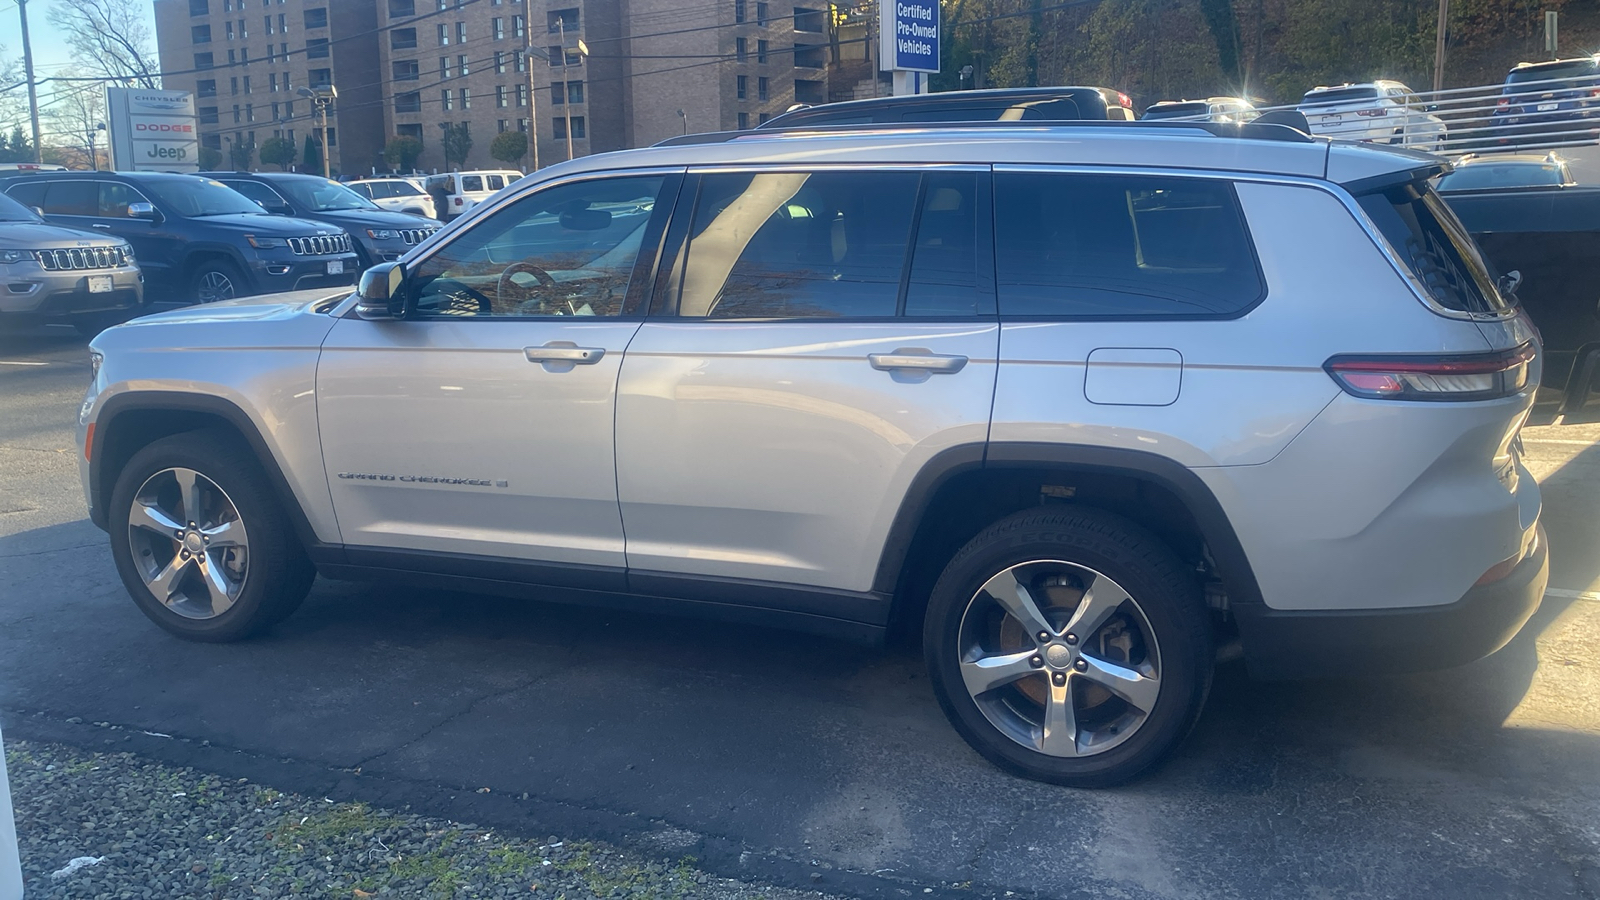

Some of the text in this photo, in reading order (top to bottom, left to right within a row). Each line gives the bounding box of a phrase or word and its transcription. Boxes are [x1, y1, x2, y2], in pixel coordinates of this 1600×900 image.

[897, 2, 932, 20] Certified
[897, 21, 937, 38] Pre-Owned
[898, 39, 932, 55] Vehicles
[134, 95, 189, 103] CHRYSLER
[135, 123, 192, 133] DODGE
[147, 143, 187, 161] Jeep
[337, 472, 396, 481] GRAND
[399, 475, 492, 486] CHEROKEE
